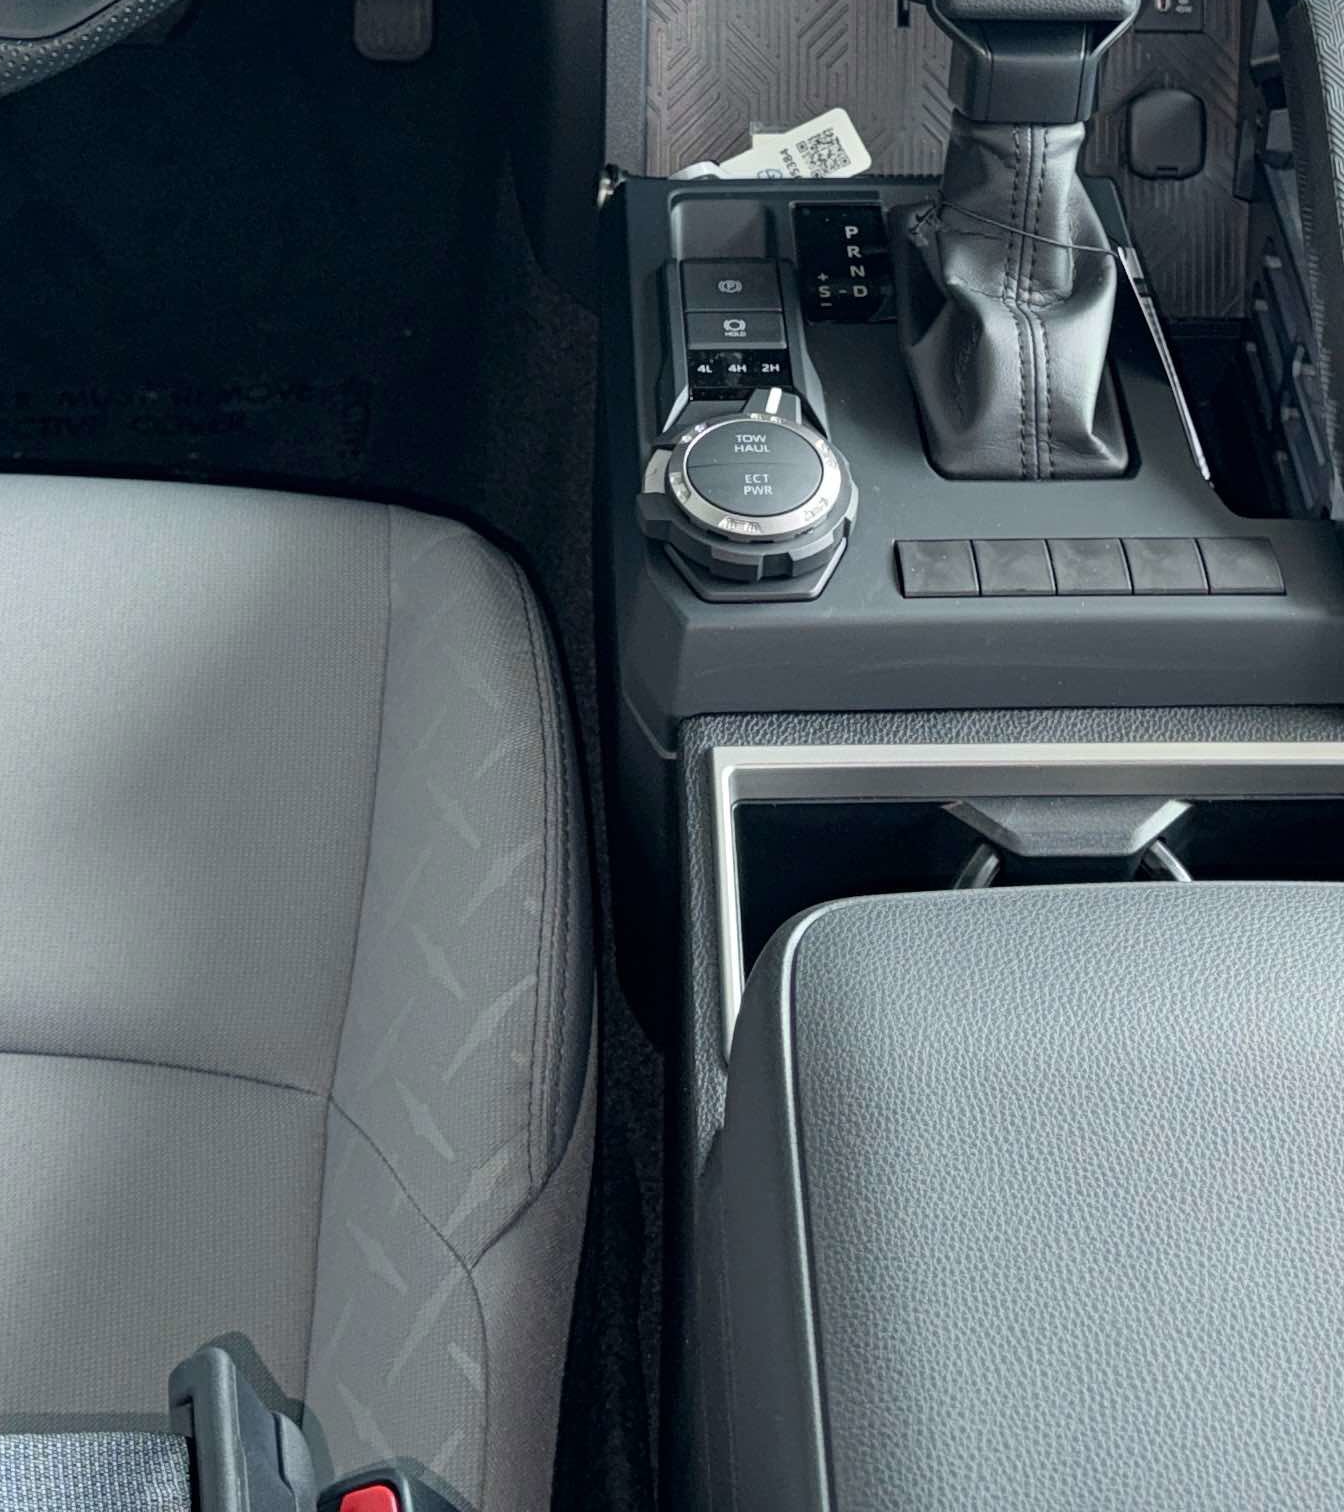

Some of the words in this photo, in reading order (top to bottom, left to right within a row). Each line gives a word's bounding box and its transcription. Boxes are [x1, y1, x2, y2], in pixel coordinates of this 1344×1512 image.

[844, 225, 858, 239] P
[847, 245, 862, 258] R
[850, 265, 865, 277] N
[818, 286, 831, 298] S
[853, 285, 868, 297] D
[697, 364, 713, 373] 4L
[728, 363, 747, 373] 4H
[761, 363, 780, 372] 2H
[735, 434, 766, 443] TOW
[734, 444, 770, 453] HAUL
[745, 474, 769, 484] ECT
[743, 485, 773, 496] PWR
